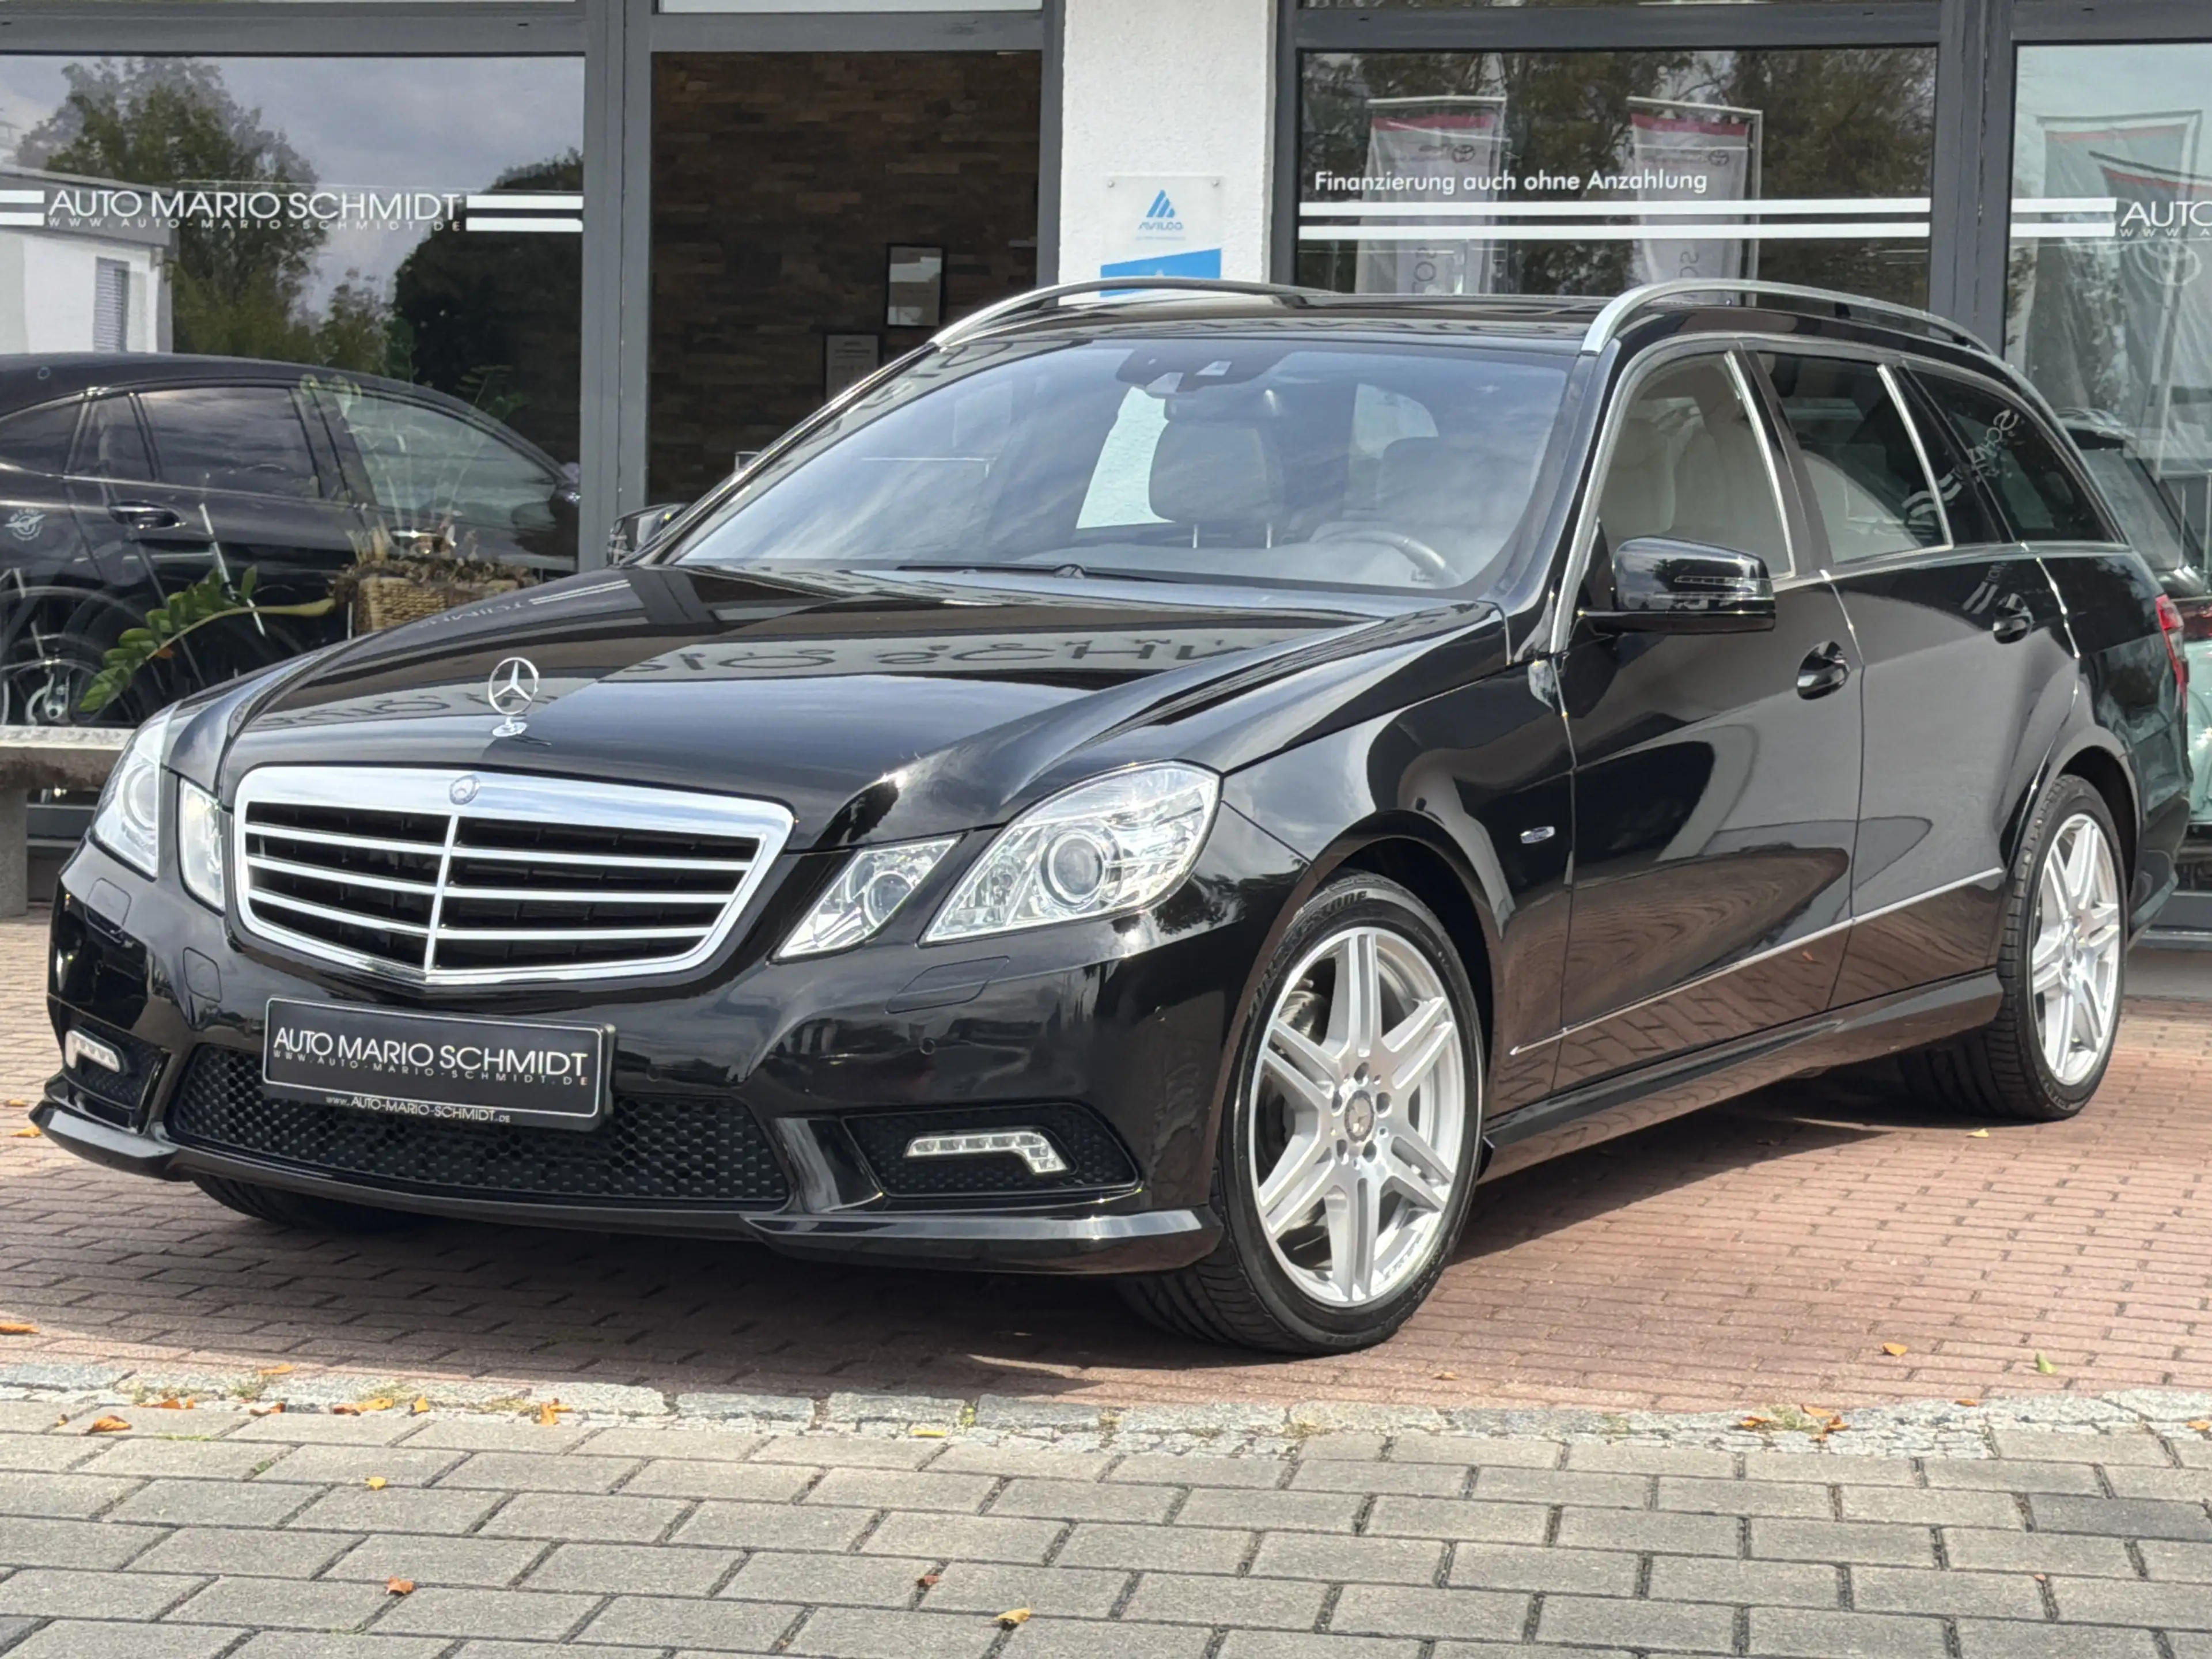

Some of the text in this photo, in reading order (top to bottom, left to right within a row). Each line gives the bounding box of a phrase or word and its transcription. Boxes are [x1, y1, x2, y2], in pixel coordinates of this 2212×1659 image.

[1316, 168, 1707, 195] Finanzierung auch ohne Anzahlung
[48, 190, 460, 220] AUTO MARIO SCHMIDT
[2120, 200, 2211, 227] AUTO
[274, 1027, 588, 1076] AUTO MARIO SCHMIDT
